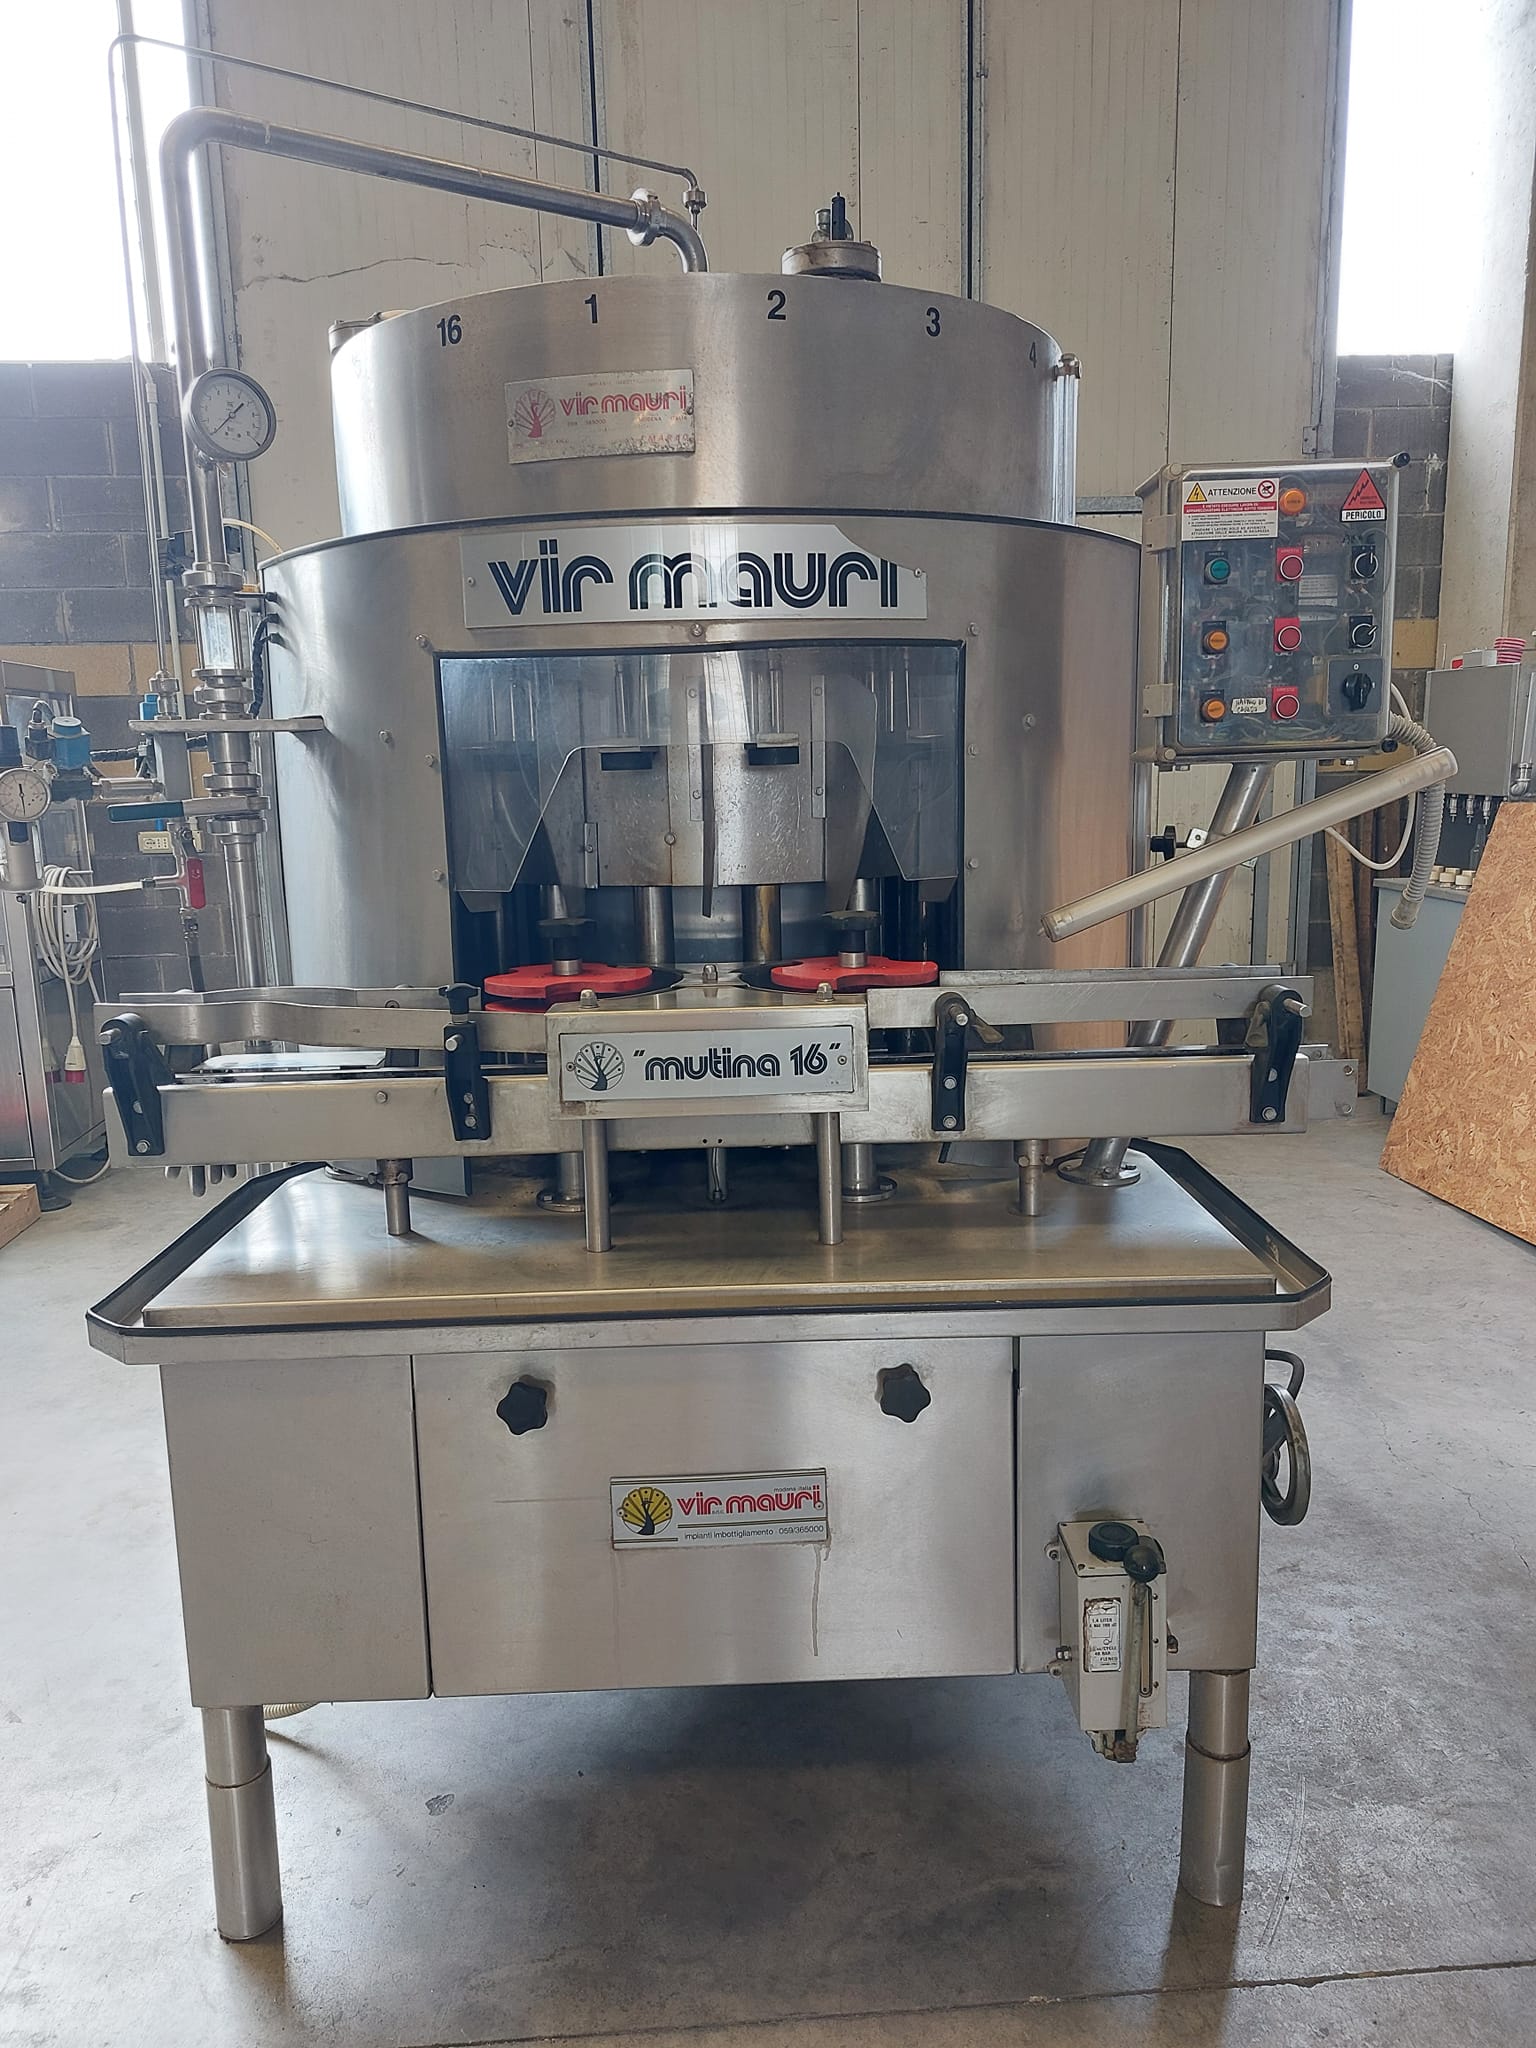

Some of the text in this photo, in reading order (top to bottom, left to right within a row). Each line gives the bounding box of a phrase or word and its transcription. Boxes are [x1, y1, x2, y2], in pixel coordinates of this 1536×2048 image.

[584, 293, 598, 324] 1
[767, 289, 787, 321] 2
[436, 314, 463, 347] 16
[926, 307, 941, 337] 3
[1029, 341, 1037, 369] 4
[559, 385, 687, 416] vir mauri
[1207, 487, 1257, 497] ATTENZIONE
[1345, 510, 1382, 520] PERICOLO
[487, 538, 898, 616] vir mauri
[676, 1491, 723, 1516] vir
[725, 1484, 820, 1514] mauri
[684, 1531, 713, 1541] impianti
[713, 1528, 774, 1539] imbottigliamento
